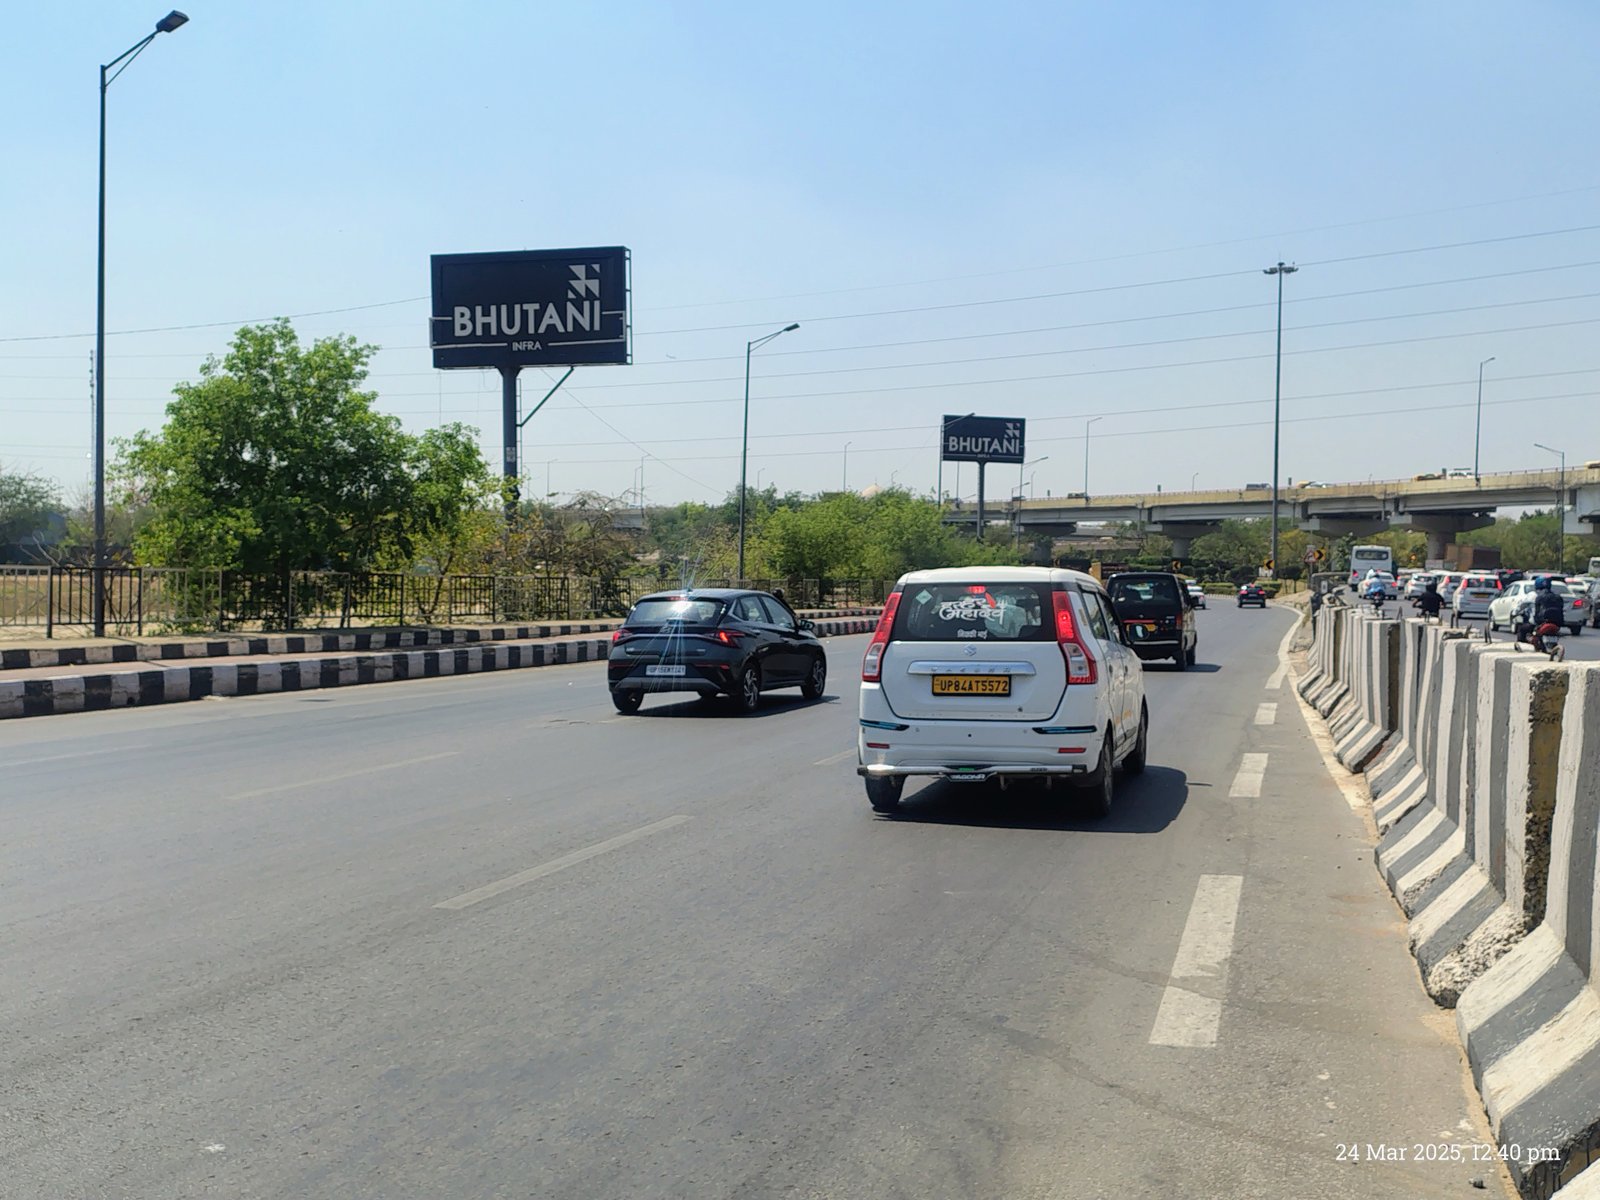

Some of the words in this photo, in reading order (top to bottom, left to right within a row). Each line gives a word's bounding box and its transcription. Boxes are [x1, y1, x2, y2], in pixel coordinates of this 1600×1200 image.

[454, 300, 600, 337] BHUTANI
[512, 340, 542, 352] INFRA
[948, 436, 1020, 454] BHUTANI
[940, 680, 1008, 692] UP84AT5572
